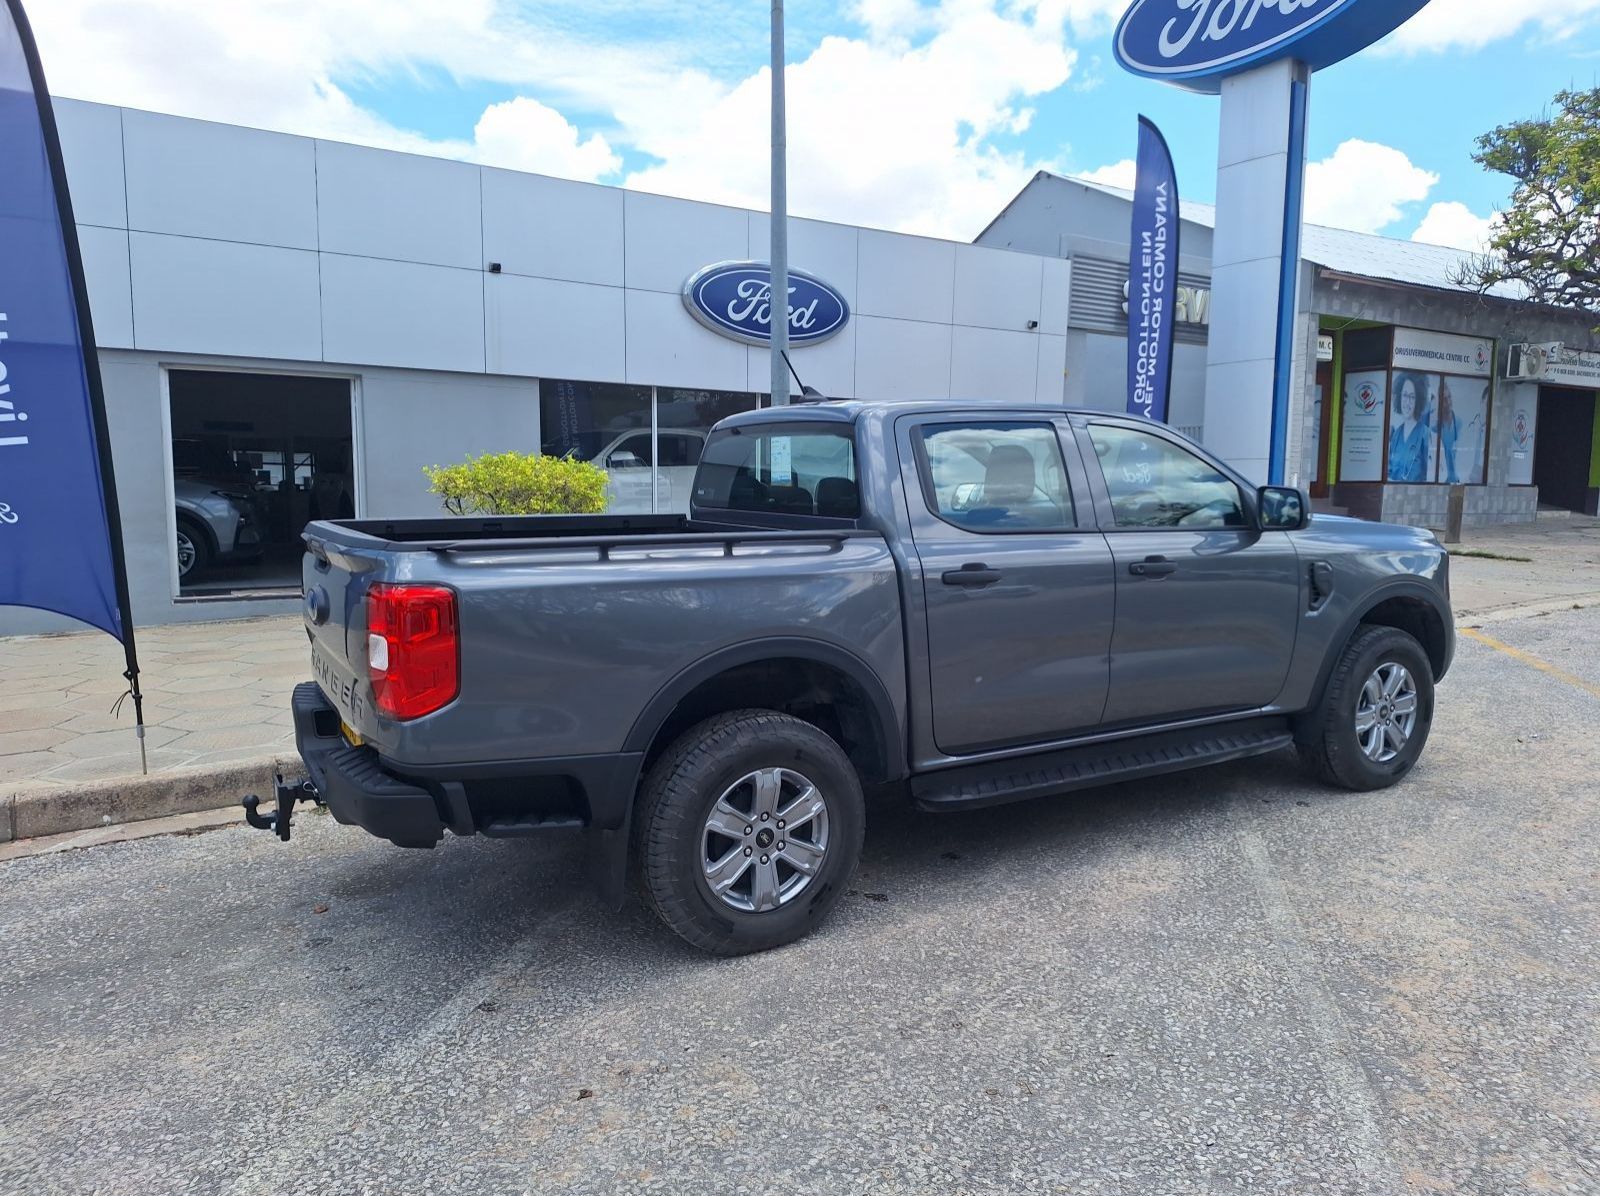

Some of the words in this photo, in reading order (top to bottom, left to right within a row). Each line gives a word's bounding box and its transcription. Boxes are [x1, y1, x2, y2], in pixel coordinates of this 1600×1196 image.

[727, 279, 819, 329] Fod
[1445, 352, 1463, 363] CENTRE
[1463, 355, 1470, 364] CC
